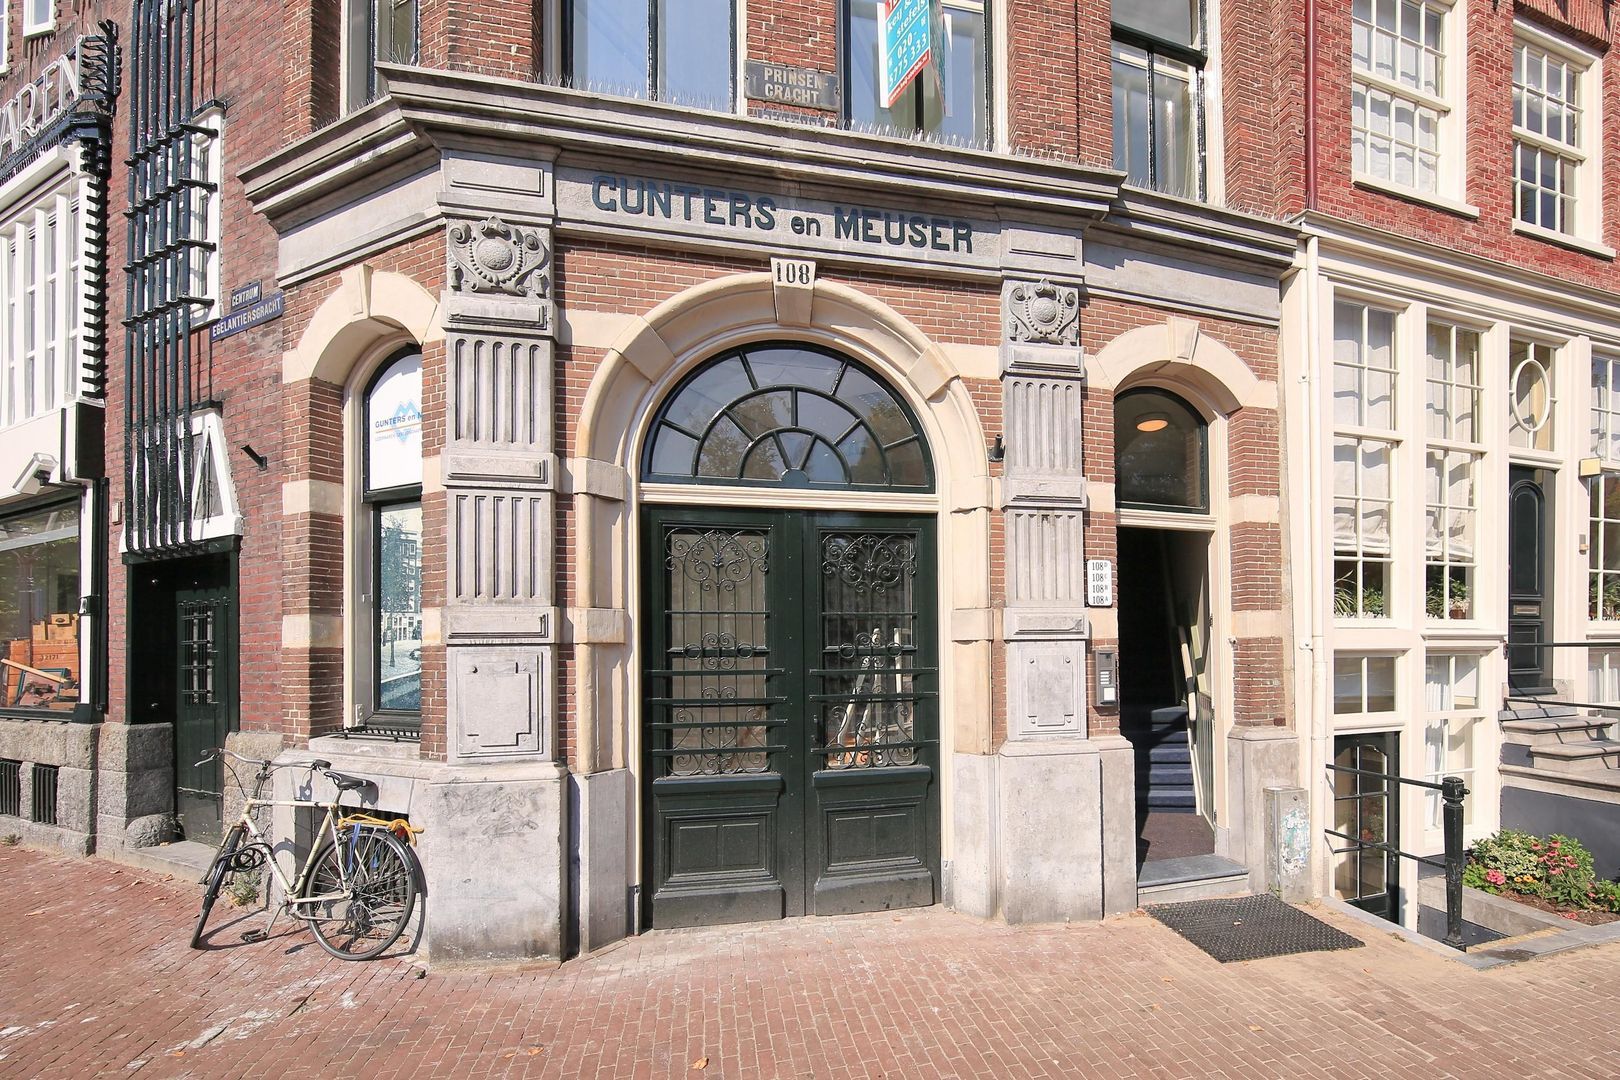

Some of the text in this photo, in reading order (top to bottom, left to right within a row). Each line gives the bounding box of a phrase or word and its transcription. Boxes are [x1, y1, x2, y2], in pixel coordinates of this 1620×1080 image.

[889, 32, 927, 87] 5775 333
[764, 67, 829, 90] PRINSEN-
[591, 175, 973, 254] GUNTERS en MEUSER
[775, 261, 810, 285] 108
[232, 285, 259, 307] CENTRUM
[212, 298, 281, 338] EGELANTIERSGRACHT
[375, 416, 406, 429] GUNTERS
[407, 414, 416, 422] en
